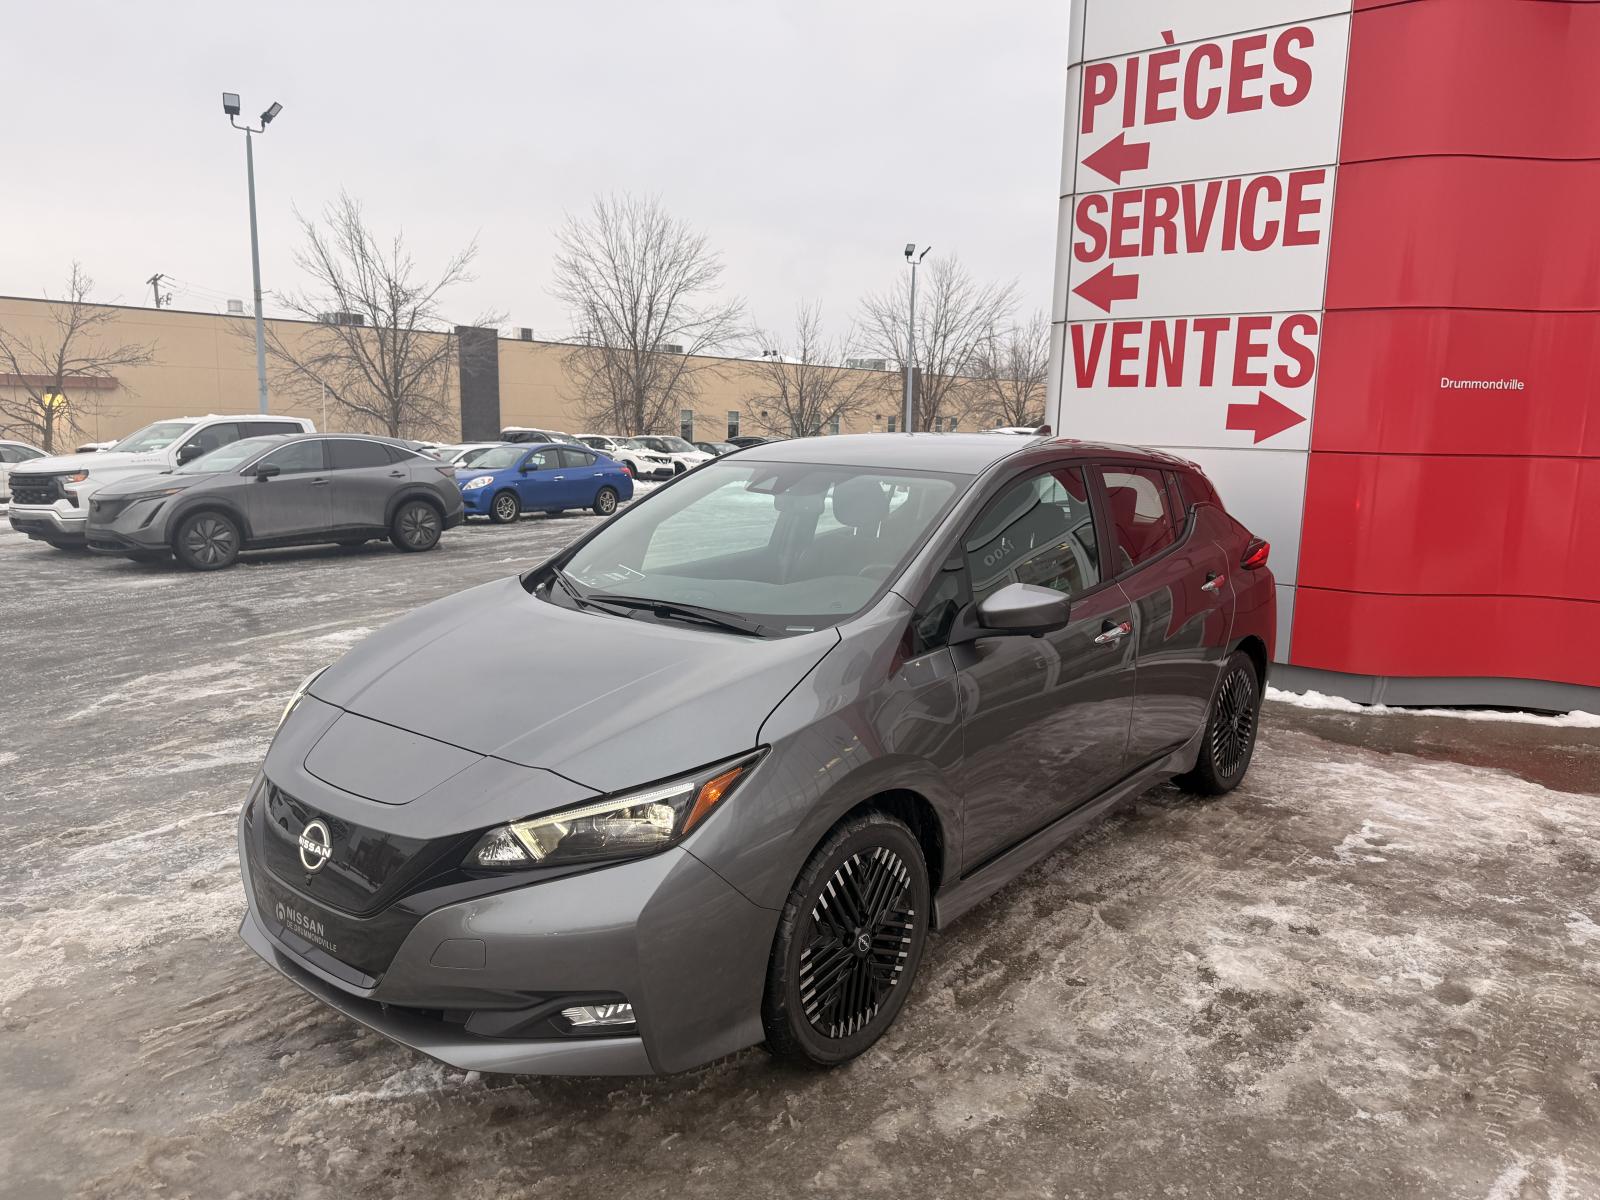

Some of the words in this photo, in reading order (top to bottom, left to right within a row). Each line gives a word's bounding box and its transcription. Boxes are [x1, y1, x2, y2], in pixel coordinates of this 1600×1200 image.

[1081, 26, 1315, 134] PIÈCES
[1073, 169, 1326, 263] SERVICE
[1070, 313, 1319, 389] VENTES
[1440, 377, 1525, 390] Drummondville
[299, 836, 332, 858] NISSAN
[286, 906, 324, 937] NISSAN
